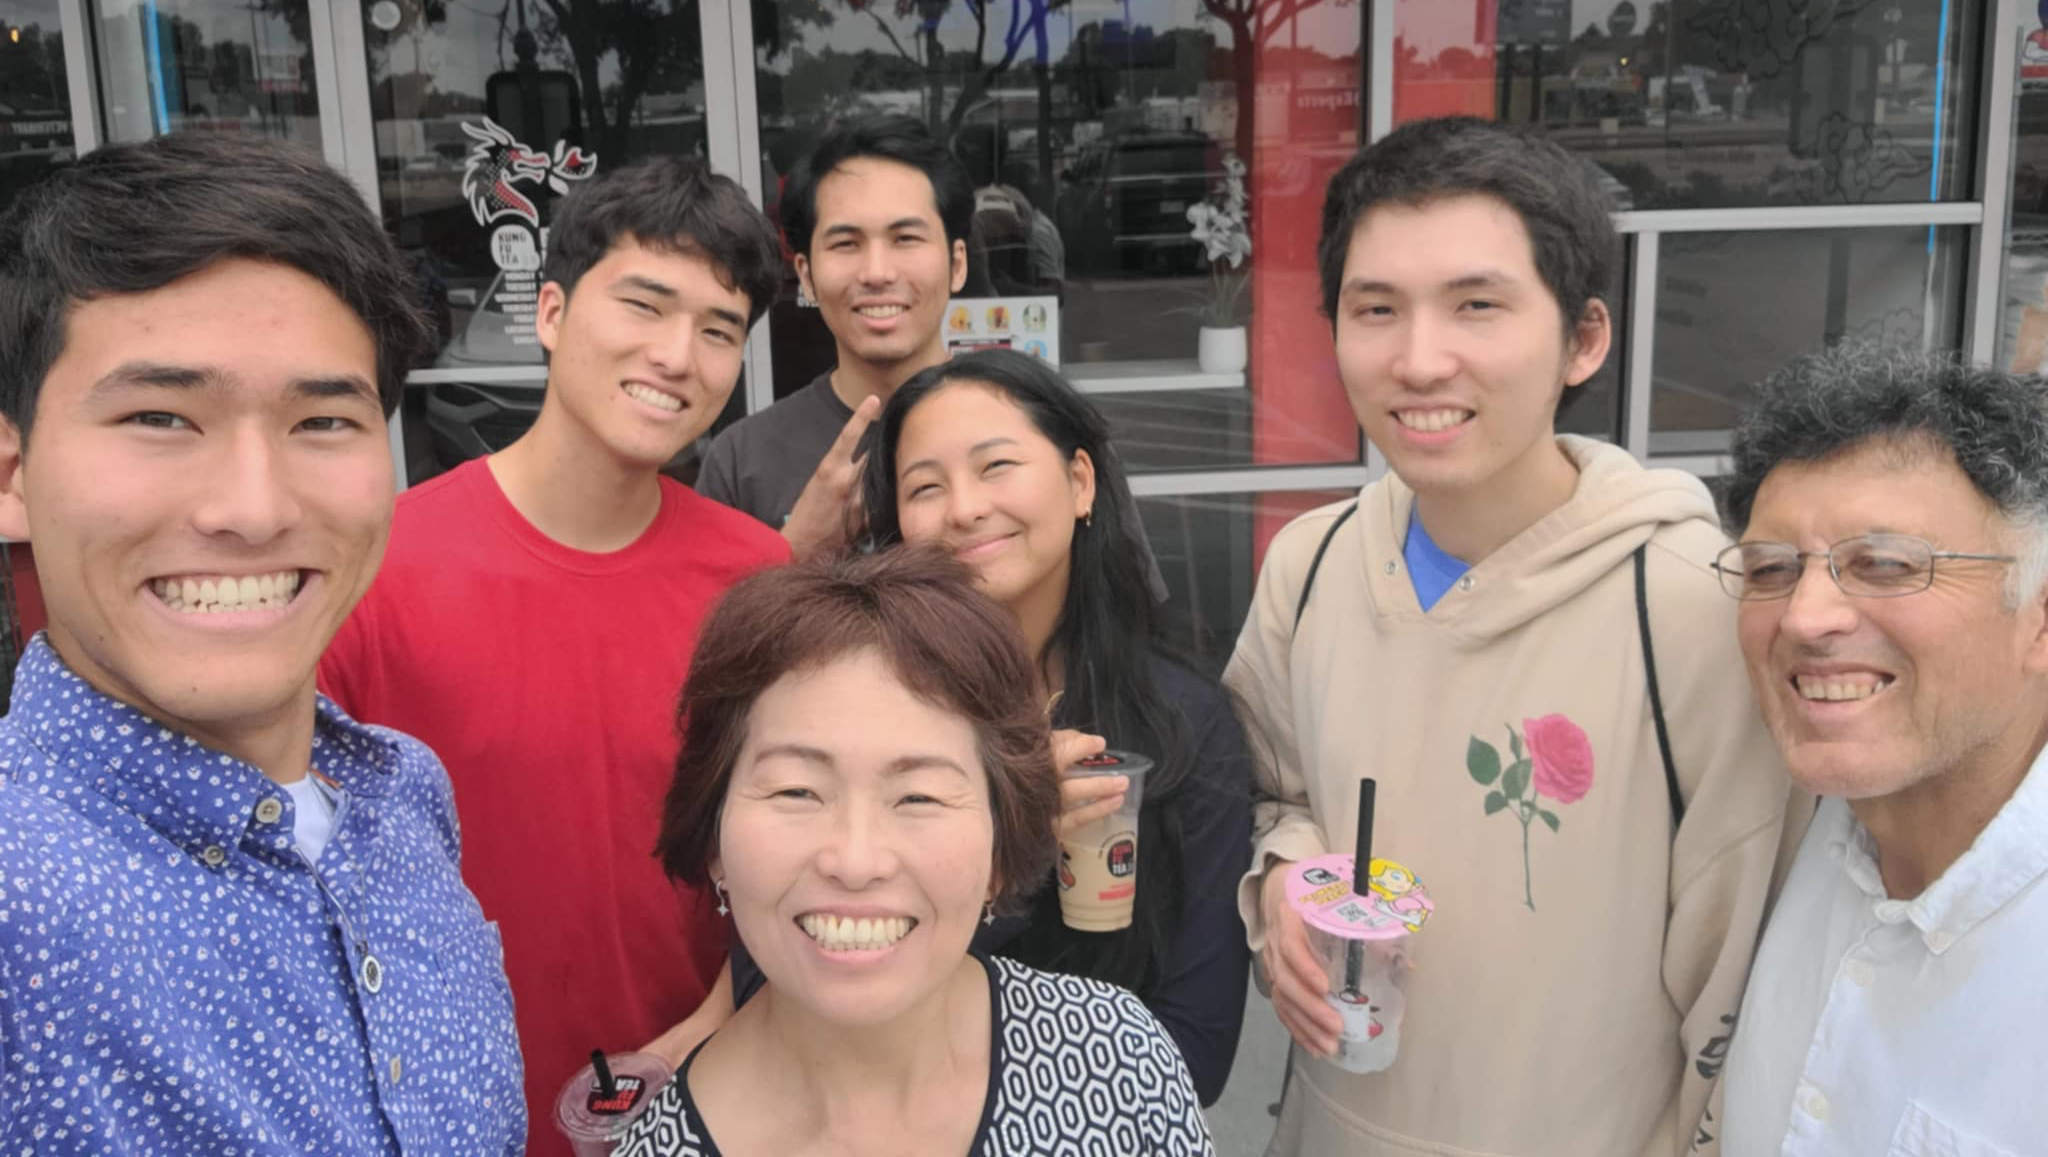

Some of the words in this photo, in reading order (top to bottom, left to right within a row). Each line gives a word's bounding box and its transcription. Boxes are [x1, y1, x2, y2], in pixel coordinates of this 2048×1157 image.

[498, 232, 528, 243] KUNG
[499, 244, 512, 253] FU
[500, 253, 519, 265] TEA
[1112, 863, 1127, 875] TEA
[615, 1079, 640, 1091] TEA
[592, 1100, 631, 1110] KUNG
